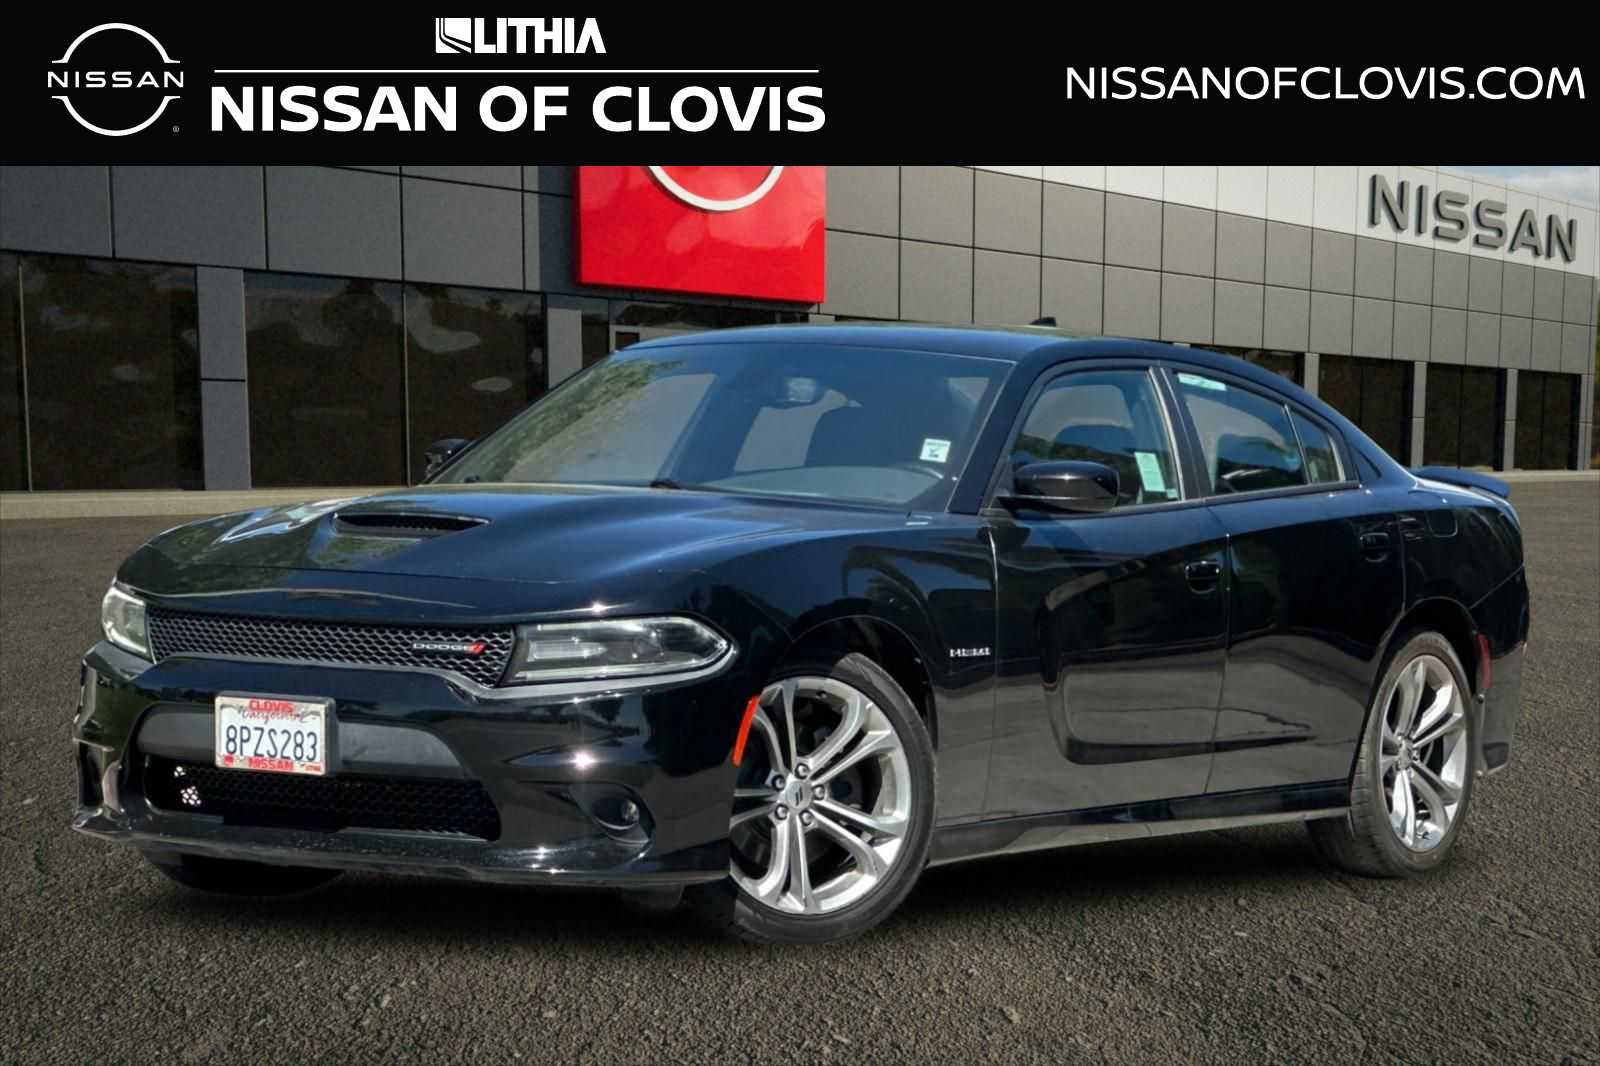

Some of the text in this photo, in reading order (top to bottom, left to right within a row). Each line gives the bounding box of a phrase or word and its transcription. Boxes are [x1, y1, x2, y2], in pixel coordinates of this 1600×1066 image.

[1368, 173, 1577, 263] NISSAN
[248, 699, 294, 713] CLOVIS
[226, 724, 317, 762] 8PZS283
[248, 757, 294, 771] NISSAN
